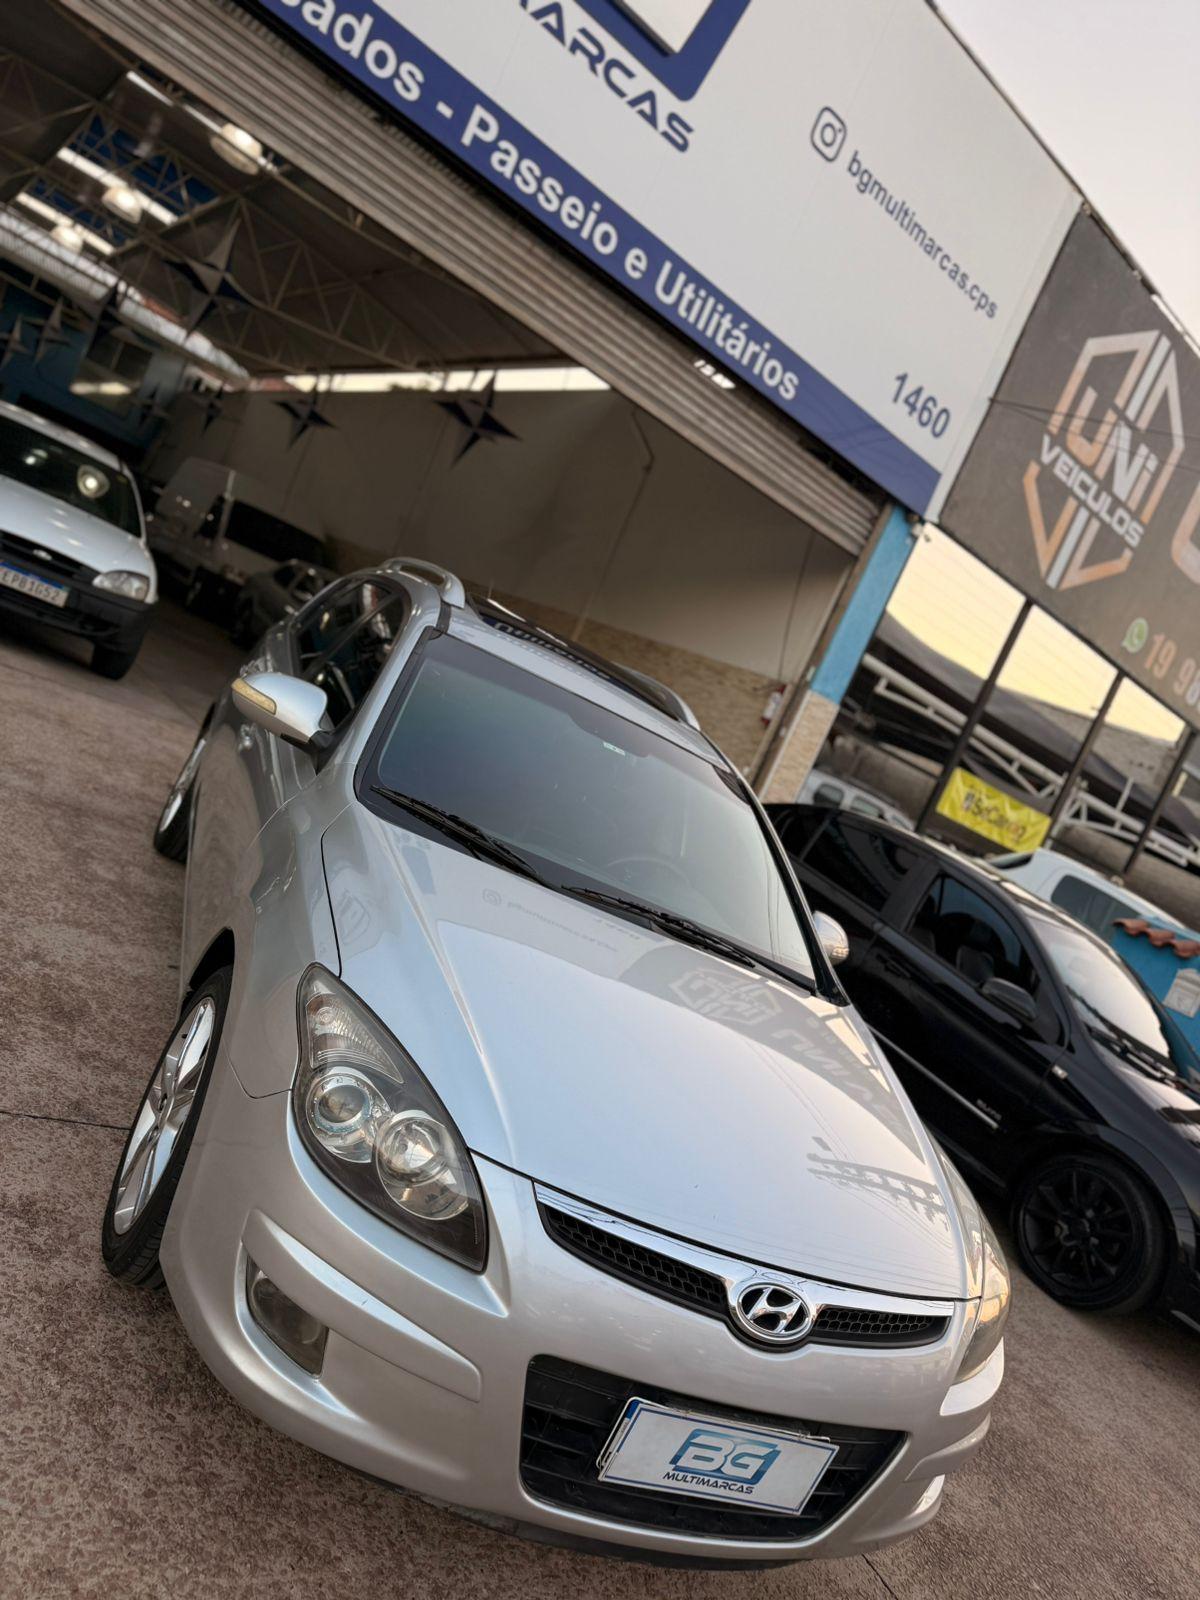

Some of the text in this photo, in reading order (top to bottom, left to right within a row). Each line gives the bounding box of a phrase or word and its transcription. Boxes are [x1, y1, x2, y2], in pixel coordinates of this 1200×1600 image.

[520, 0, 694, 153] ARCAS
[279, 0, 424, 101] ados
[461, 104, 618, 256] Passeio
[624, 246, 649, 280] e
[655, 260, 799, 400] Utilitários
[846, 150, 998, 319] bgmultimarcas.cps
[892, 373, 951, 438] 1460
[1041, 433, 1145, 548] VEICULOS
[1144, 632, 1177, 680] 19
[663, 1471, 754, 1494] MULTIMARCAS
[674, 1432, 776, 1481] BG
